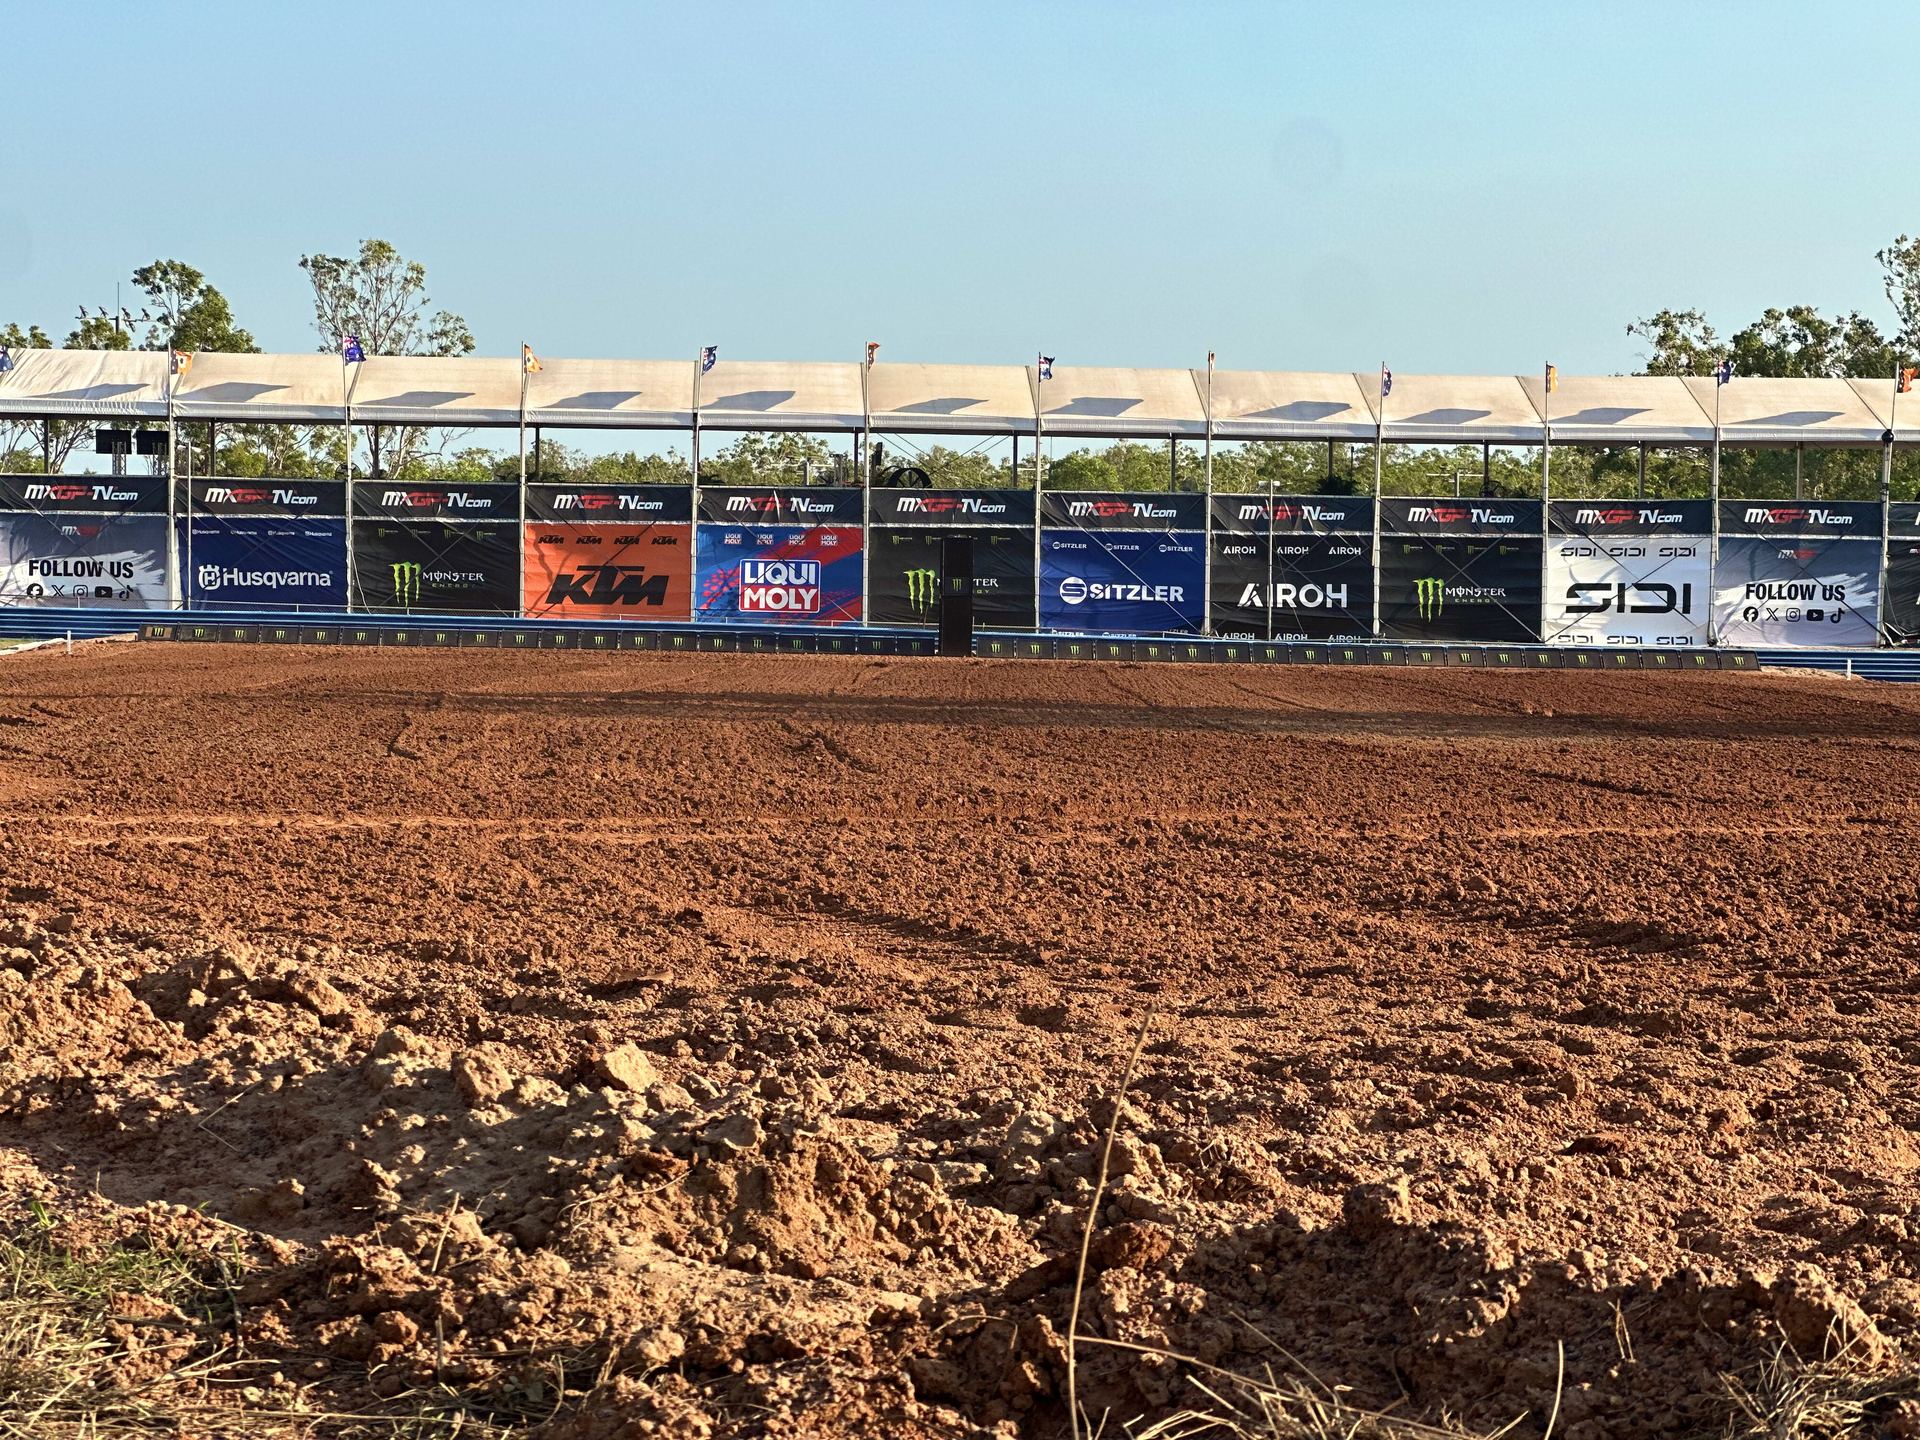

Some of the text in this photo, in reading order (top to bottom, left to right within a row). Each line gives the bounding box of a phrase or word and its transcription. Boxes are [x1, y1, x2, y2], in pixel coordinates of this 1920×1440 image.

[538, 535, 564, 544] KTM
[576, 536, 602, 544] KTM
[614, 536, 640, 544] KTM
[652, 536, 677, 545] KTM
[1223, 546, 1256, 554] AIROH
[1328, 547, 1361, 555] AIROH
[1560, 548, 1596, 556] SIDI
[1609, 548, 1646, 556] SIDI
[1659, 548, 1696, 557] SIDI
[29, 560, 134, 578] FOLLOW US
[222, 568, 332, 588] Husqvarna
[422, 570, 484, 582] MONSTER
[744, 562, 816, 586] LIQUI
[545, 565, 670, 605] KTM
[1089, 583, 1185, 602] SITZLER
[1237, 583, 1348, 608] AIROH
[1445, 586, 1506, 597] MONSTER
[1746, 584, 1846, 601] FOLLOW US
[744, 587, 818, 610] MOLY
[1566, 583, 1691, 614] SIDI
[1558, 635, 1593, 644] SIDI
[1606, 636, 1643, 644] SIDI
[1656, 636, 1693, 645] SIDI
